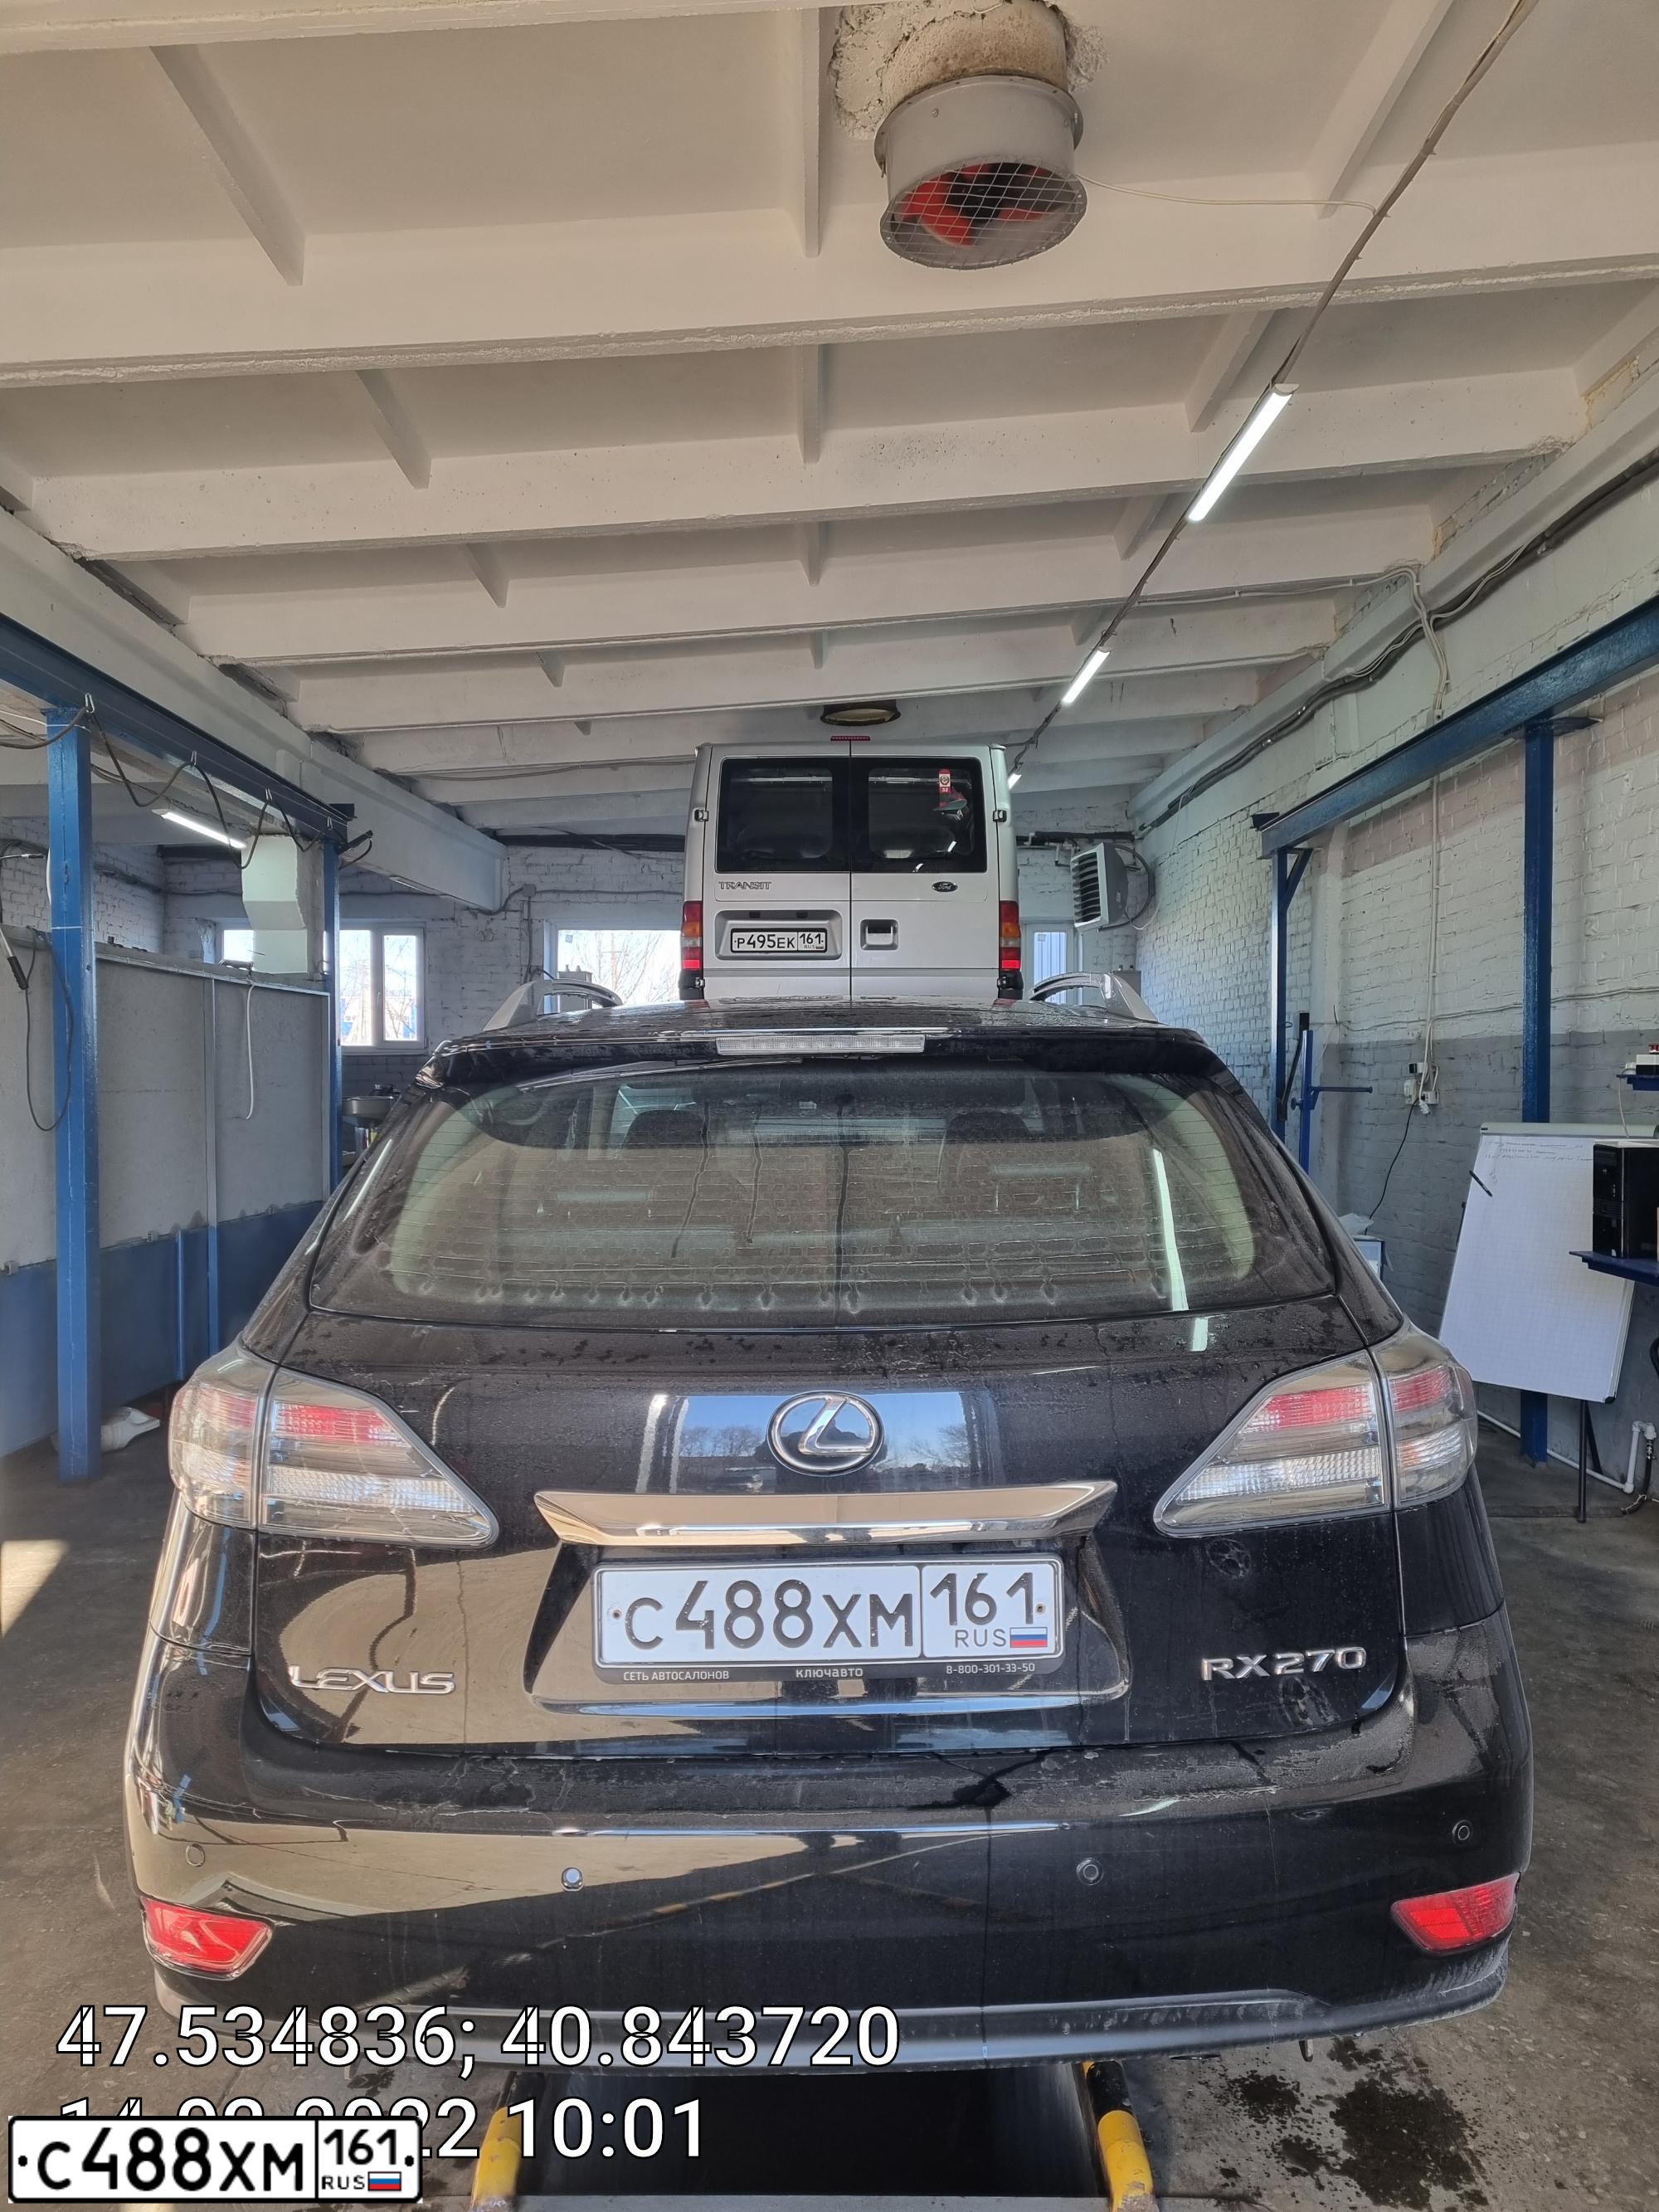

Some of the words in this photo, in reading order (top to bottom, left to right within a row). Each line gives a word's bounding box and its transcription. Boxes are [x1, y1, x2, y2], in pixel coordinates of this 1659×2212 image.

[718, 881, 771, 889] TRANSIT
[800, 933, 821, 944] 161
[930, 1572, 1034, 1626] 161
[955, 1629, 1006, 1648] RUS
[623, 1671, 649, 1681] СЕТЬ
[651, 1670, 730, 1680] АВТОСАЛОНОВ
[946, 1663, 1035, 1674] 8-800-301-33-50
[1201, 1654, 1270, 1681] RX
[1274, 1646, 1367, 1675] 270
[288, 1665, 455, 1695] LEXUS
